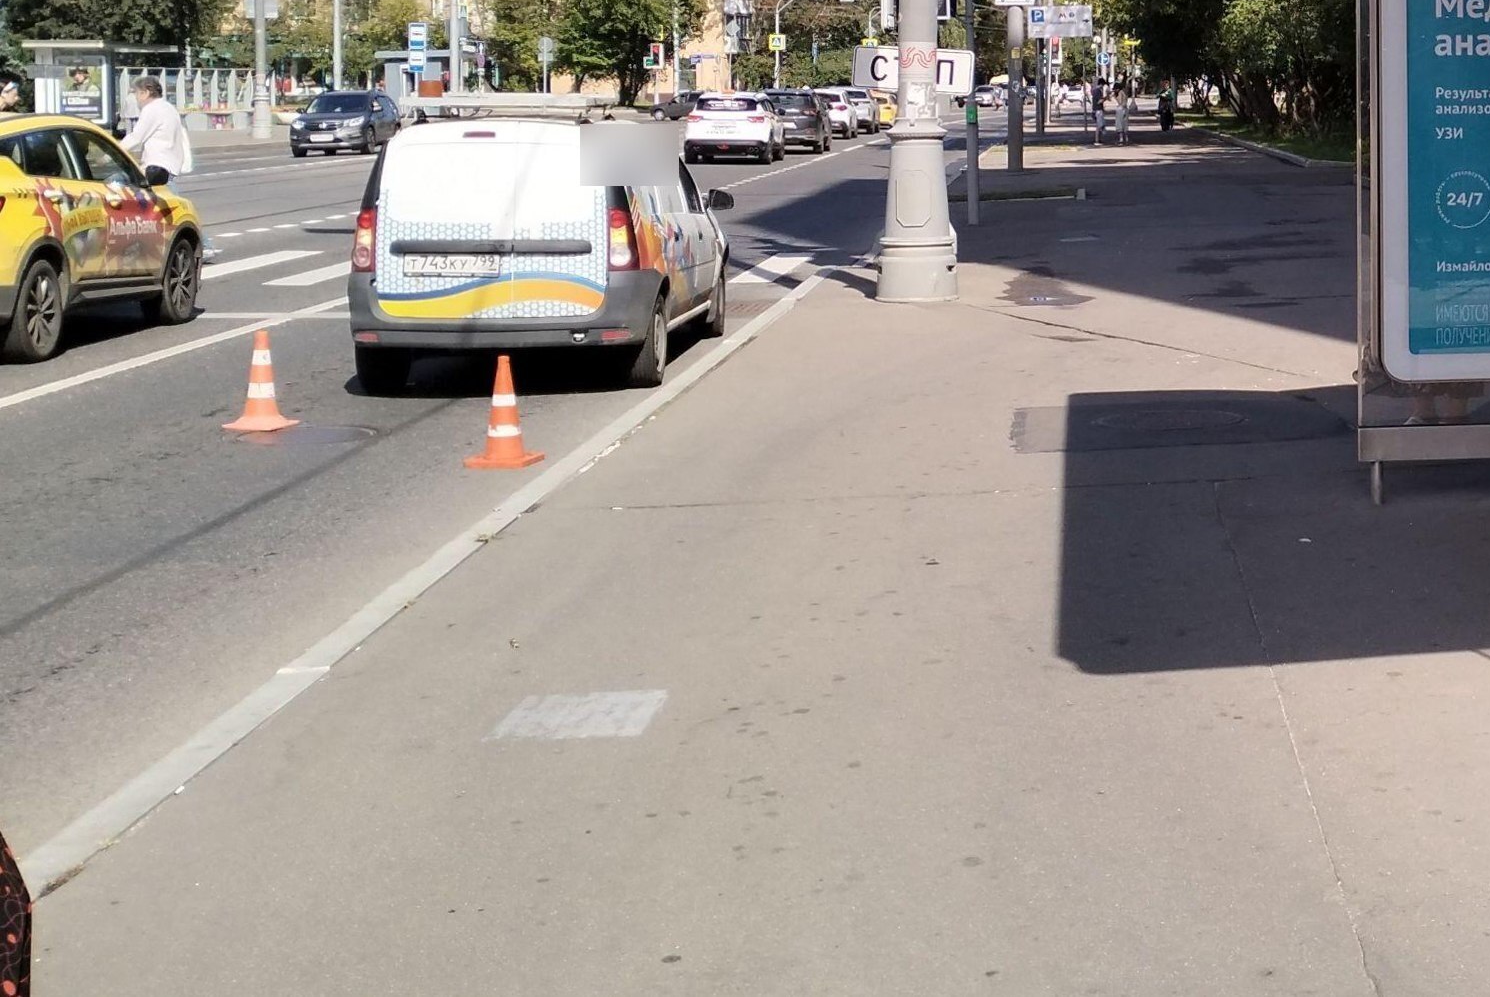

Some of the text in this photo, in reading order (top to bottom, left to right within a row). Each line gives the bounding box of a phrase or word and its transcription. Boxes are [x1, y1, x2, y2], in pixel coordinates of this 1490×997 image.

[870, 55, 955, 86] СП
[1435, 126, 1464, 140] УЗИ
[1446, 192, 1484, 208] 24/7
[1435, 303, 1489, 323] ИМЕЮТСЯ
